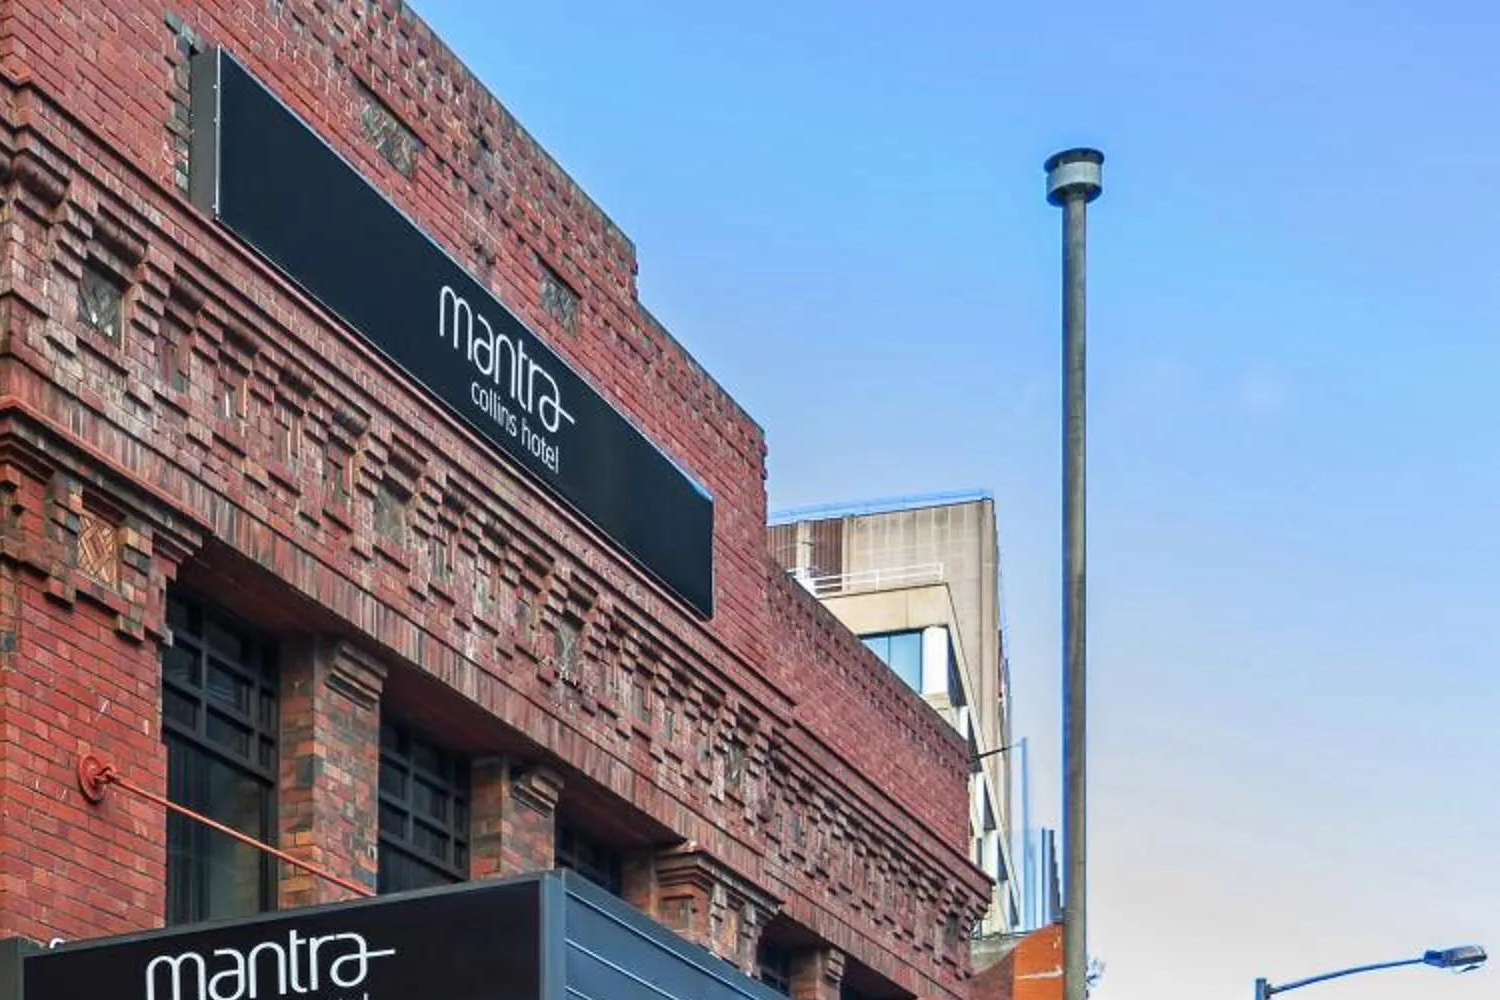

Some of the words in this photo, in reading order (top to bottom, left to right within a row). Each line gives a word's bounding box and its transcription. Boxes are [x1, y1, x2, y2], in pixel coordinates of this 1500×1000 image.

[438, 285, 576, 434] mantra
[470, 380, 518, 436] collins
[521, 419, 560, 475] hotel
